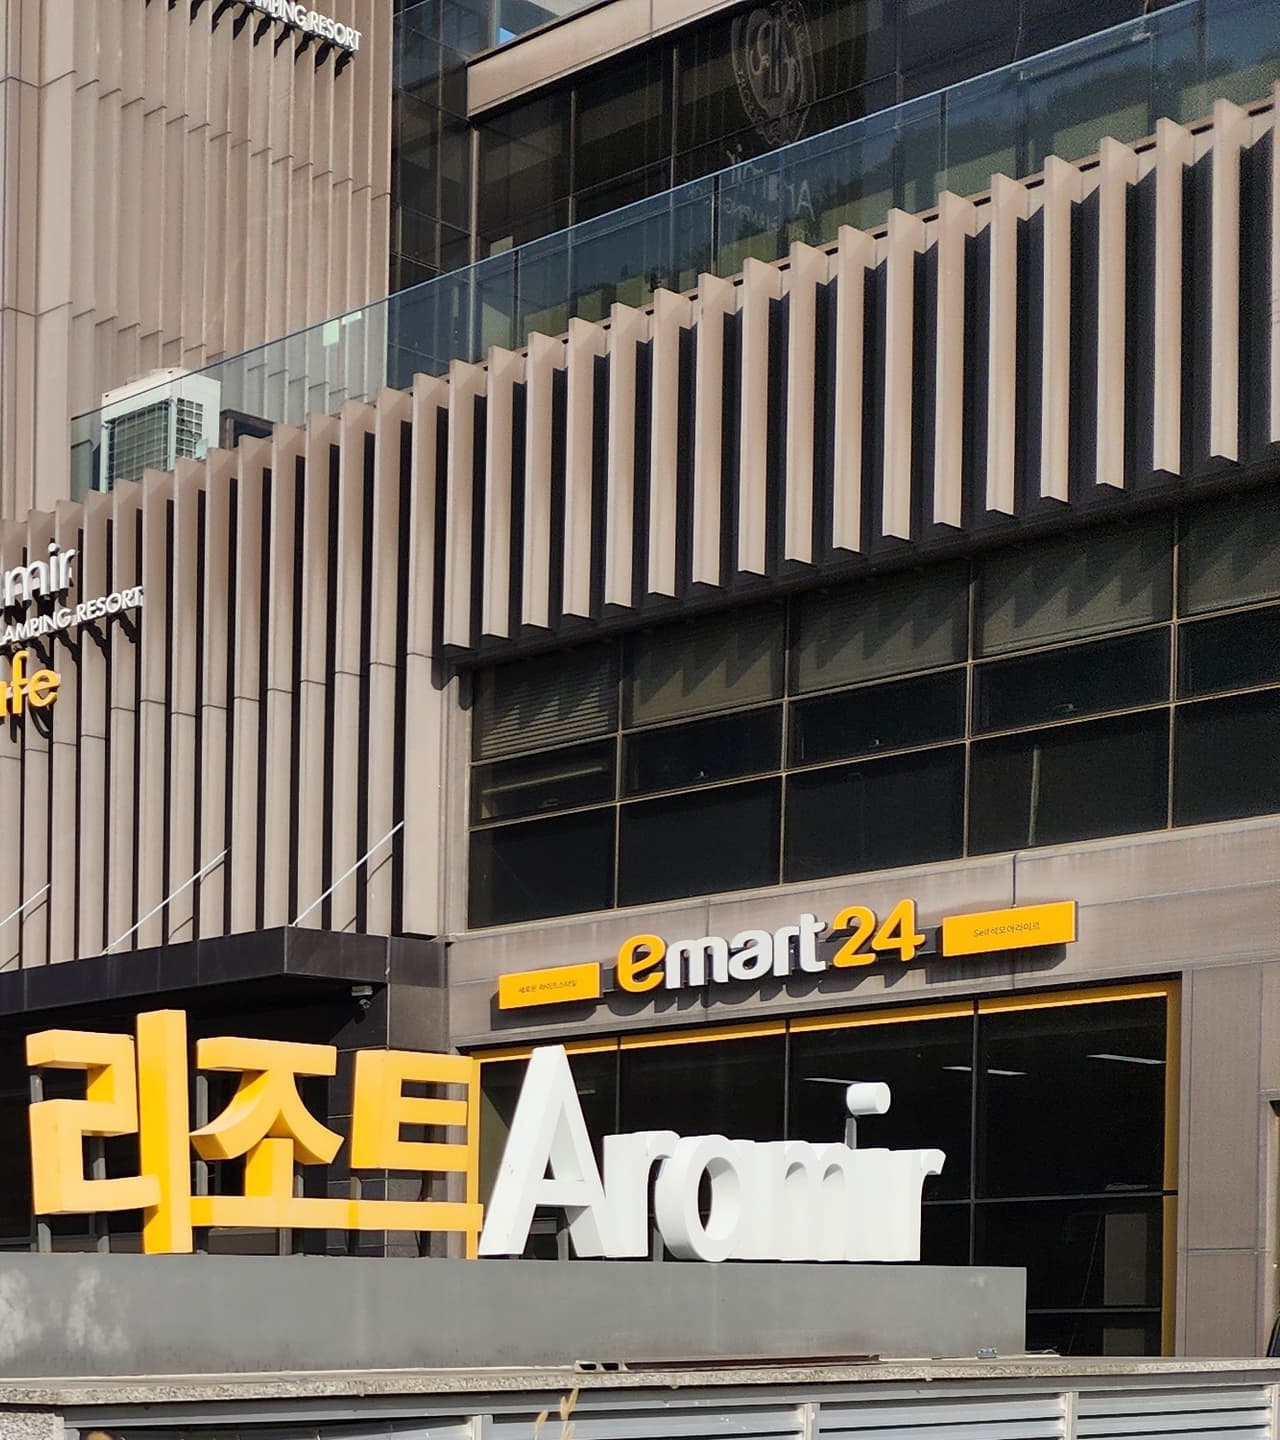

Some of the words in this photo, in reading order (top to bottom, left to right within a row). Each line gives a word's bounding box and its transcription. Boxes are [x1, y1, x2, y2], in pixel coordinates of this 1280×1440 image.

[308, 10, 362, 51] RESORT
[73, 585, 144, 626] RESORT
[616, 898, 927, 993] emart24
[24, 1008, 483, 1261] 리조트
[479, 1044, 946, 1262] Aramir
